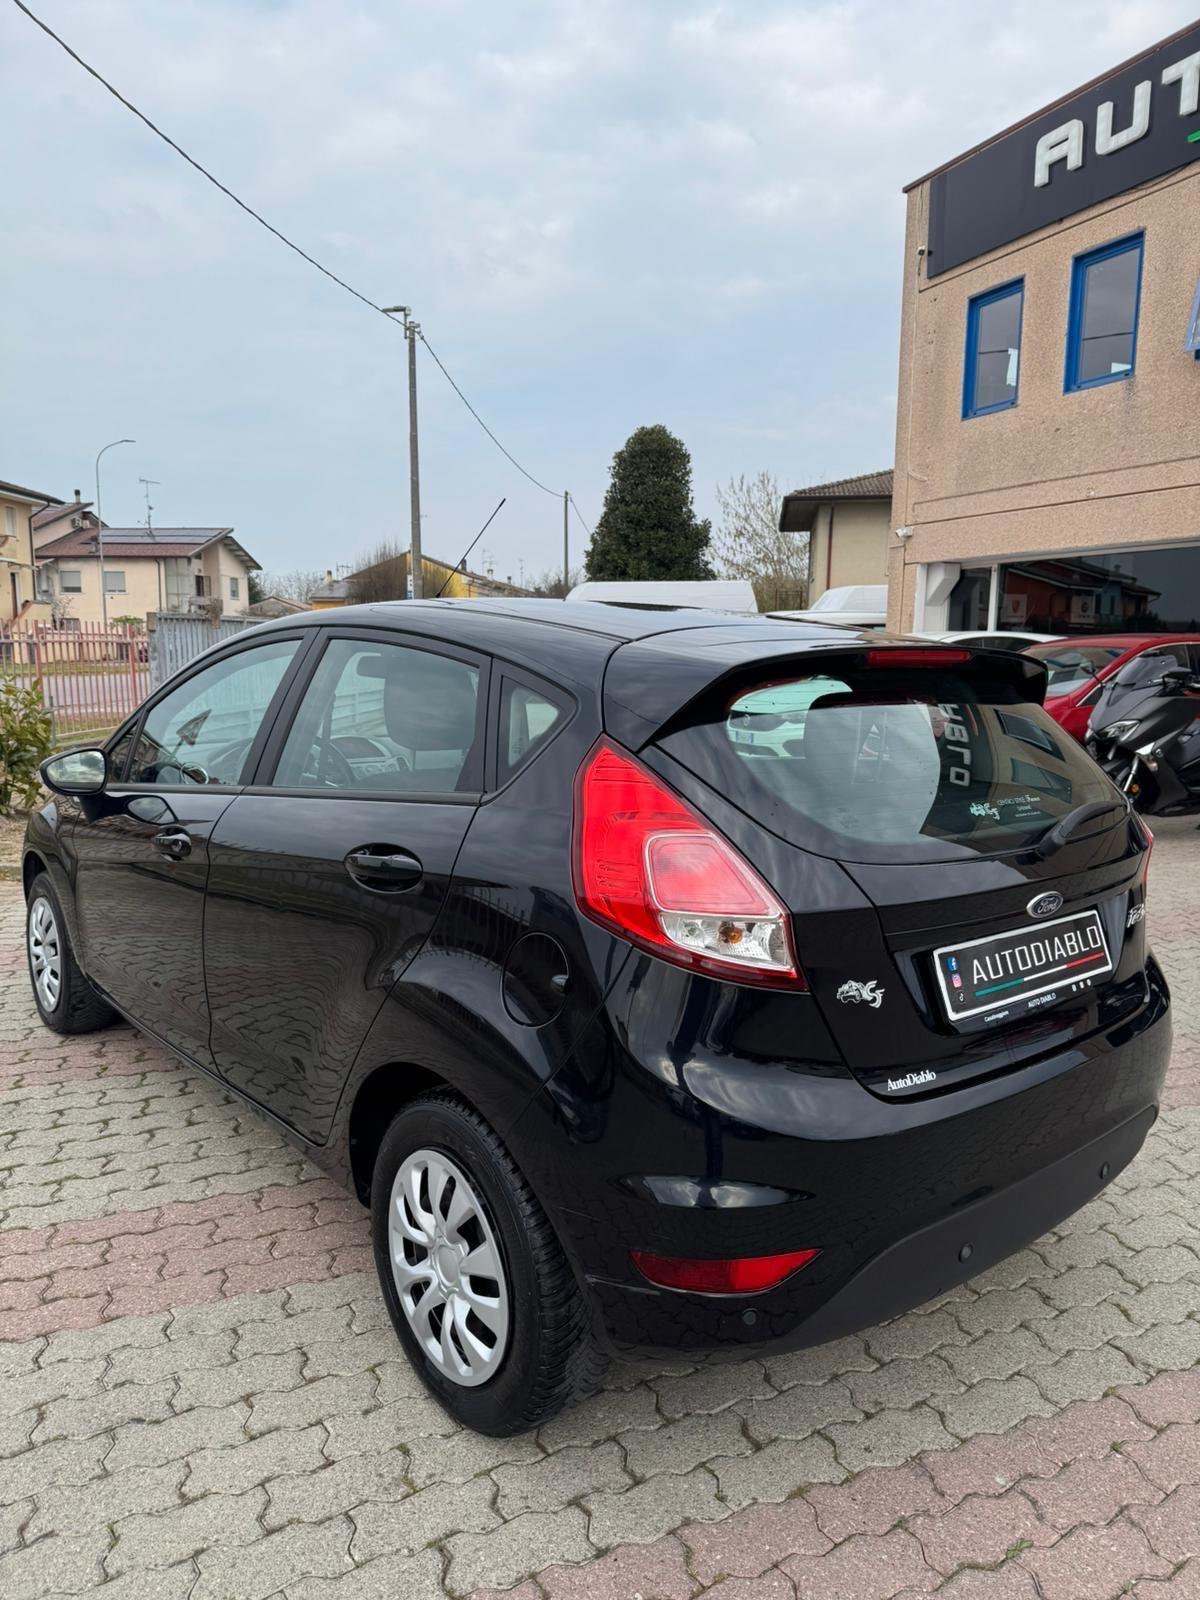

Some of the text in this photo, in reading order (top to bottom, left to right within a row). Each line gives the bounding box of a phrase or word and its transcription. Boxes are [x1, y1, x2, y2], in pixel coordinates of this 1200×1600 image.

[1037, 896, 1058, 913] Ford
[973, 925, 1101, 984] AUTODIABLO
[887, 1069, 937, 1091] AutoDiablo
